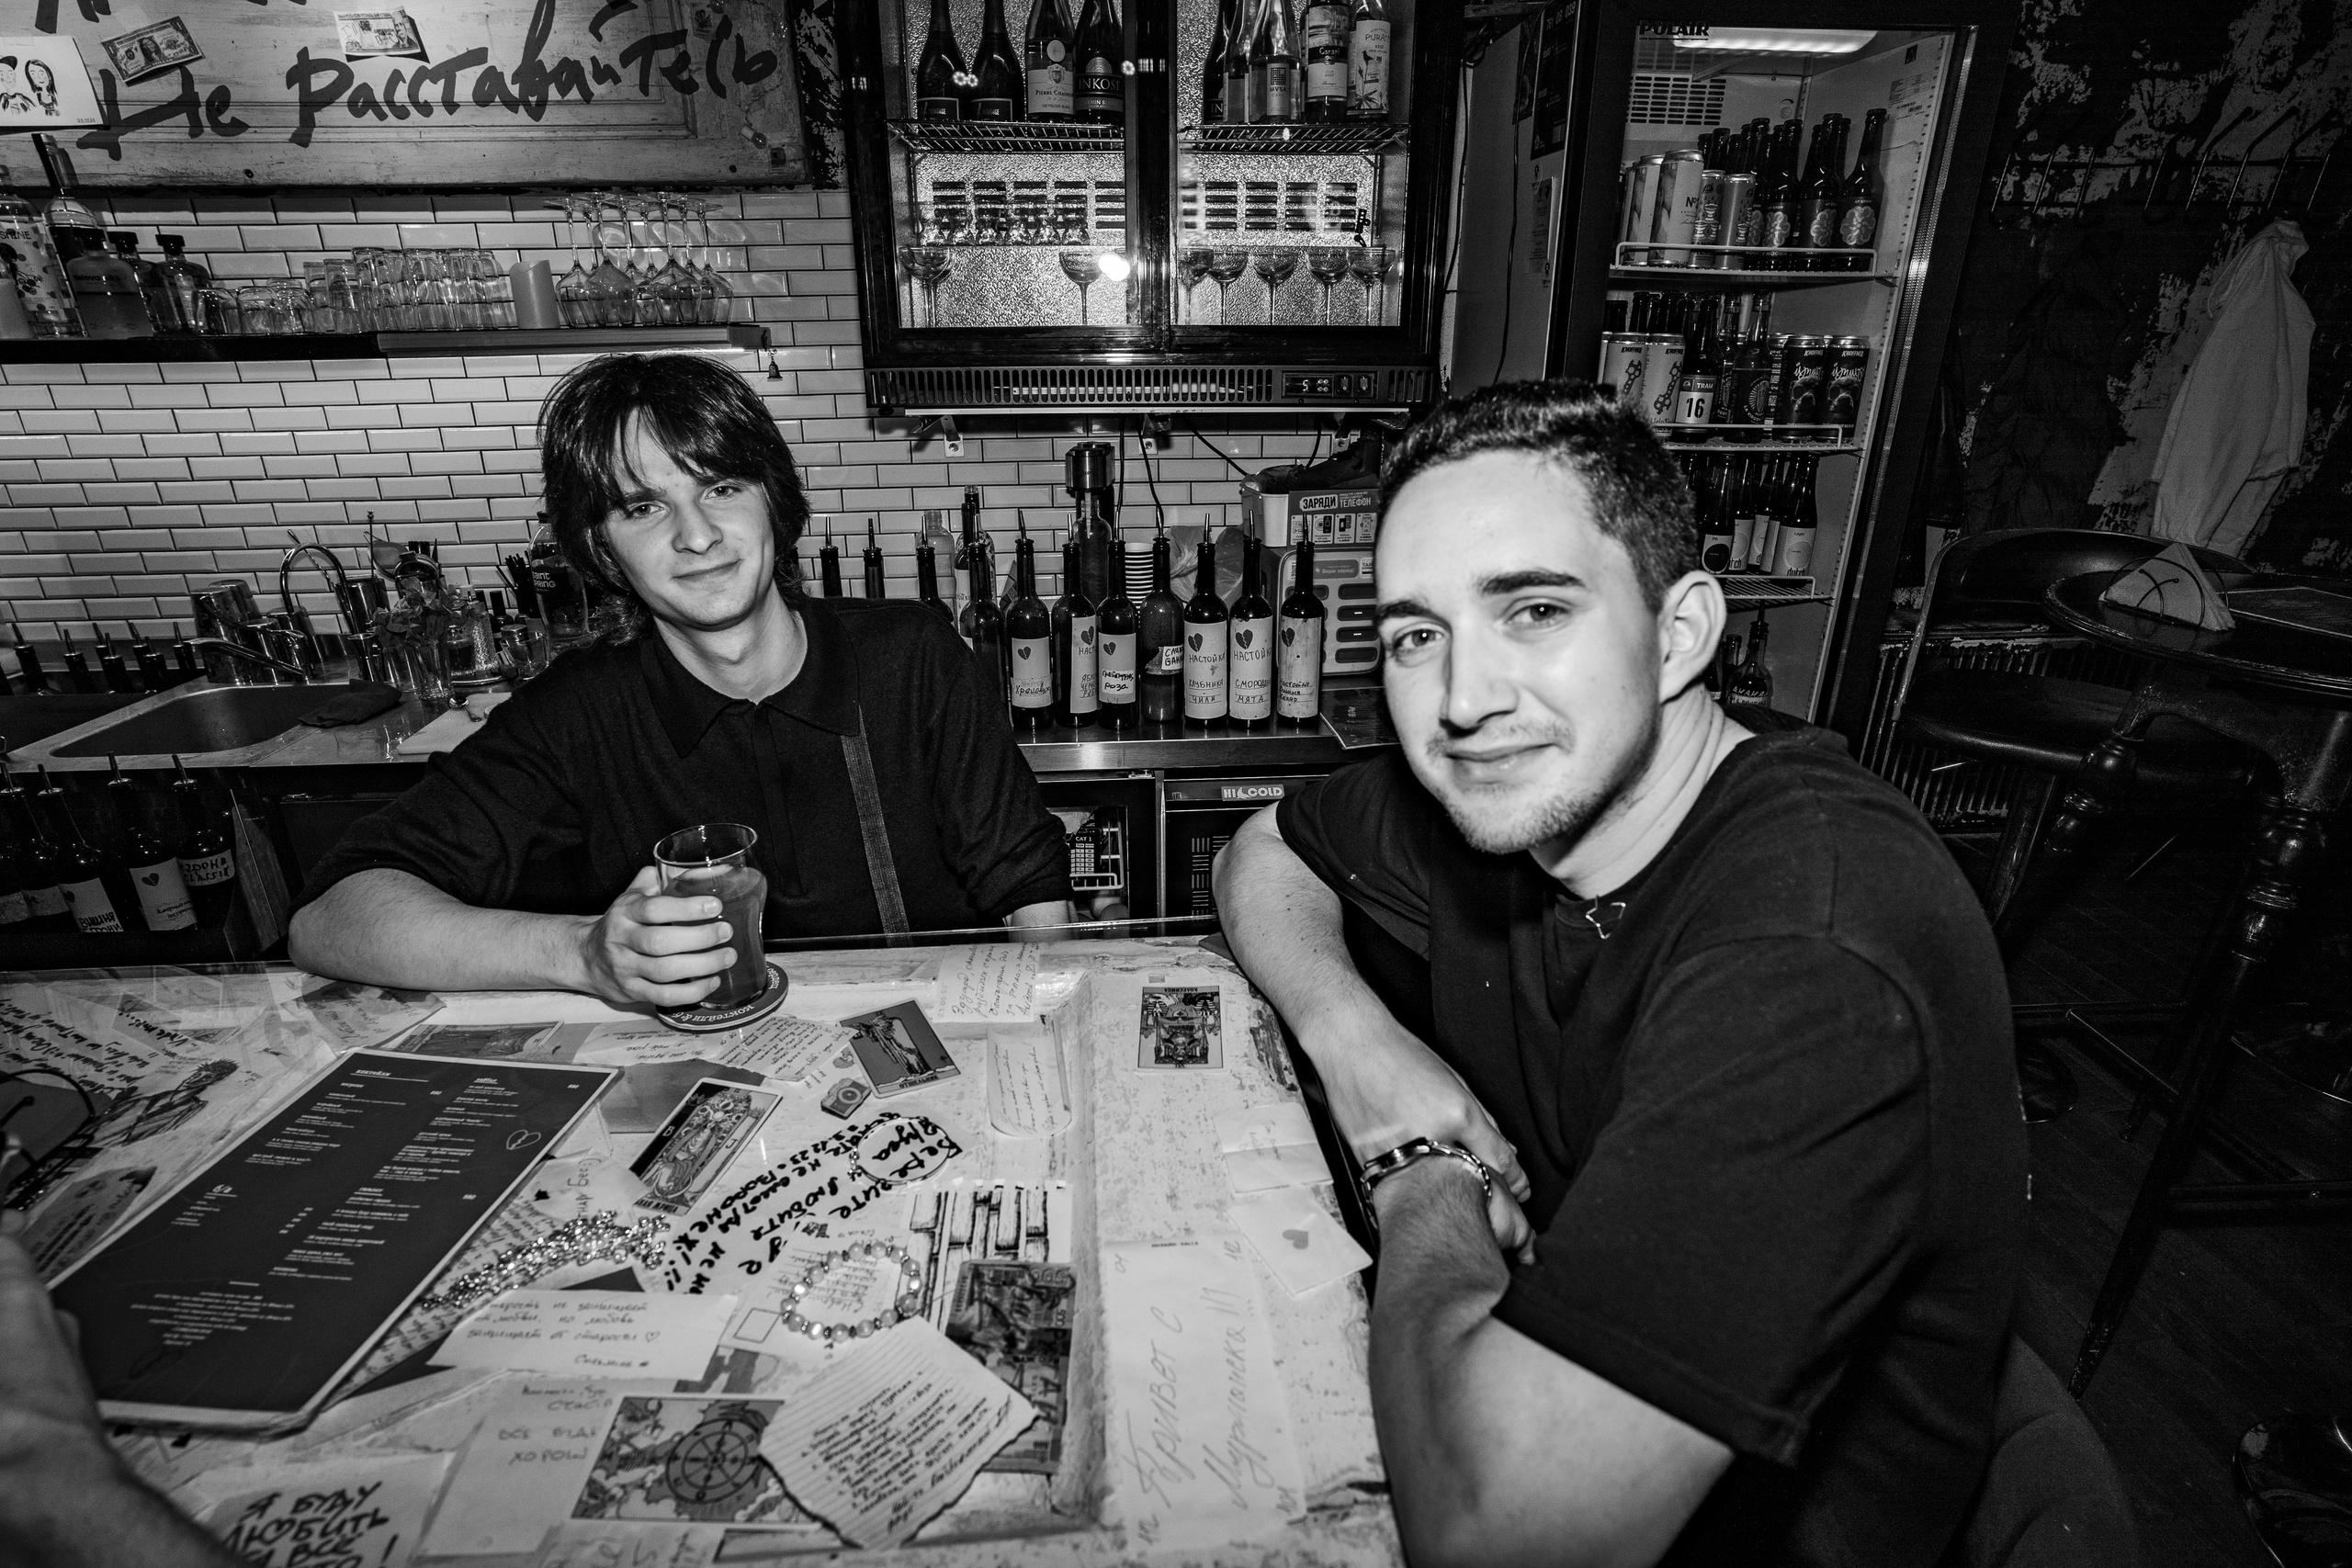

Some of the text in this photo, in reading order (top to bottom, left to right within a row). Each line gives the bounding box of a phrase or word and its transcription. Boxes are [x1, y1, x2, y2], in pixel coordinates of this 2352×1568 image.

[1638, 20, 1711, 36] POLAIR
[76, 67, 250, 161] Не
[1686, 397, 1705, 419] 16
[1303, 496, 1372, 510] ЗАРЯДИ ТЕЛЕФОН
[1237, 695, 1265, 704] МЯТА
[78, 910, 115, 928] ВИШНЯ
[692, 1004, 755, 1023] коктейли
[662, 1125, 675, 1137] B
[1122, 1337, 1197, 1511] Привет
[1201, 1325, 1276, 1511] Мурманска
